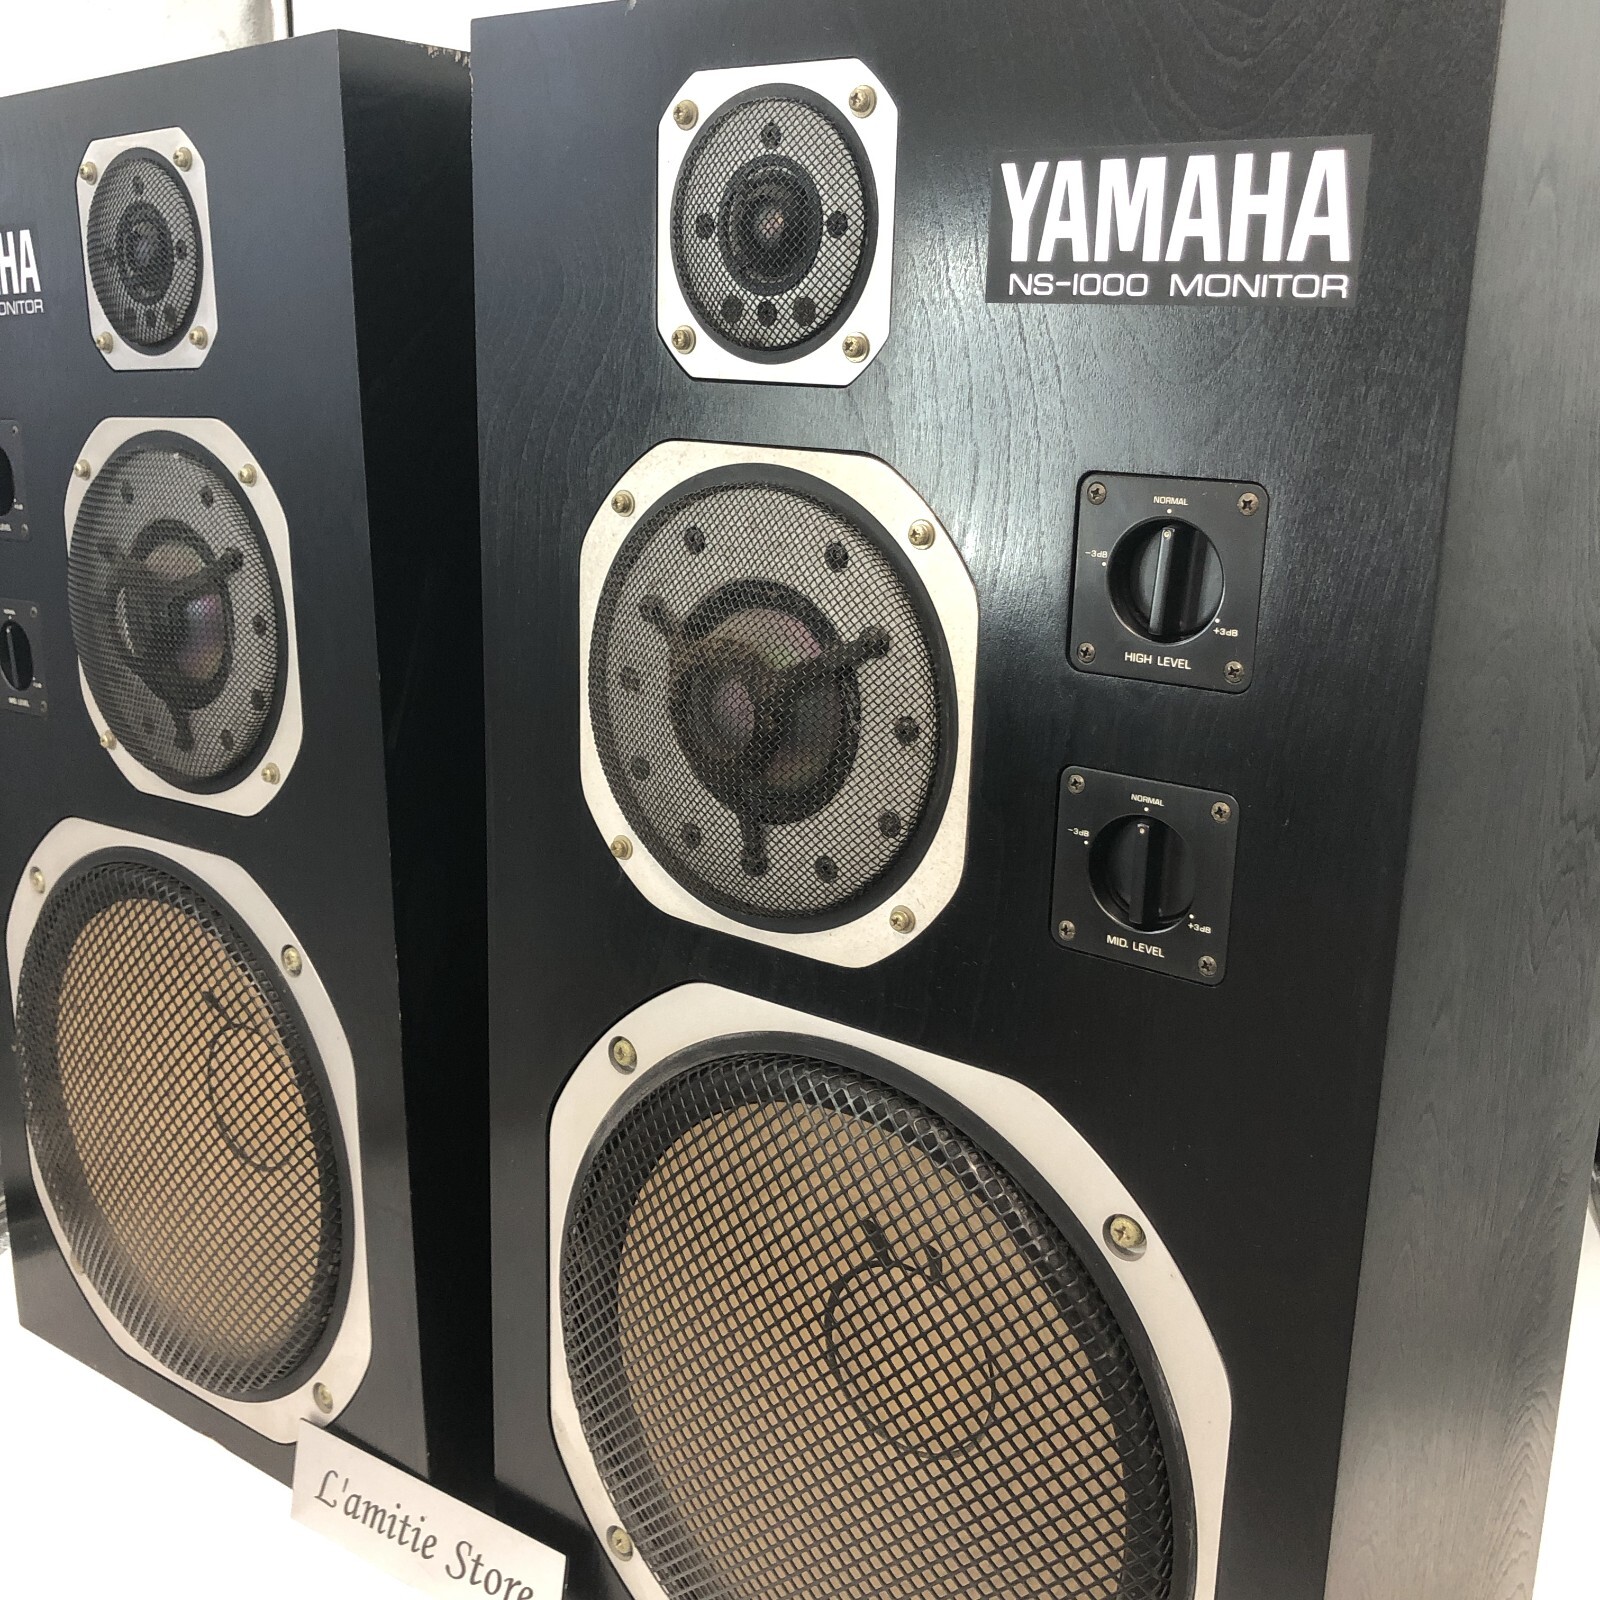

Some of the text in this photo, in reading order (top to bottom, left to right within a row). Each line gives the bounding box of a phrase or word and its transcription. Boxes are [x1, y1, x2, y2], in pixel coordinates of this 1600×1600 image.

[1001, 149, 1351, 262] YAMAHA
[1008, 273, 1349, 299] NS-1000 MONITOR
[1153, 496, 1188, 506] NORMAL
[1085, 550, 1108, 559] -3dB
[1213, 627, 1238, 637] +3dB
[1124, 651, 1191, 670] HIGH LEVEL
[1131, 793, 1164, 807] NORMAL
[1067, 828, 1089, 837] -3dB
[1188, 922, 1211, 934] +3dB
[1106, 934, 1164, 958] MID. LEVEL
[314, 1469, 437, 1560] L'amitie
